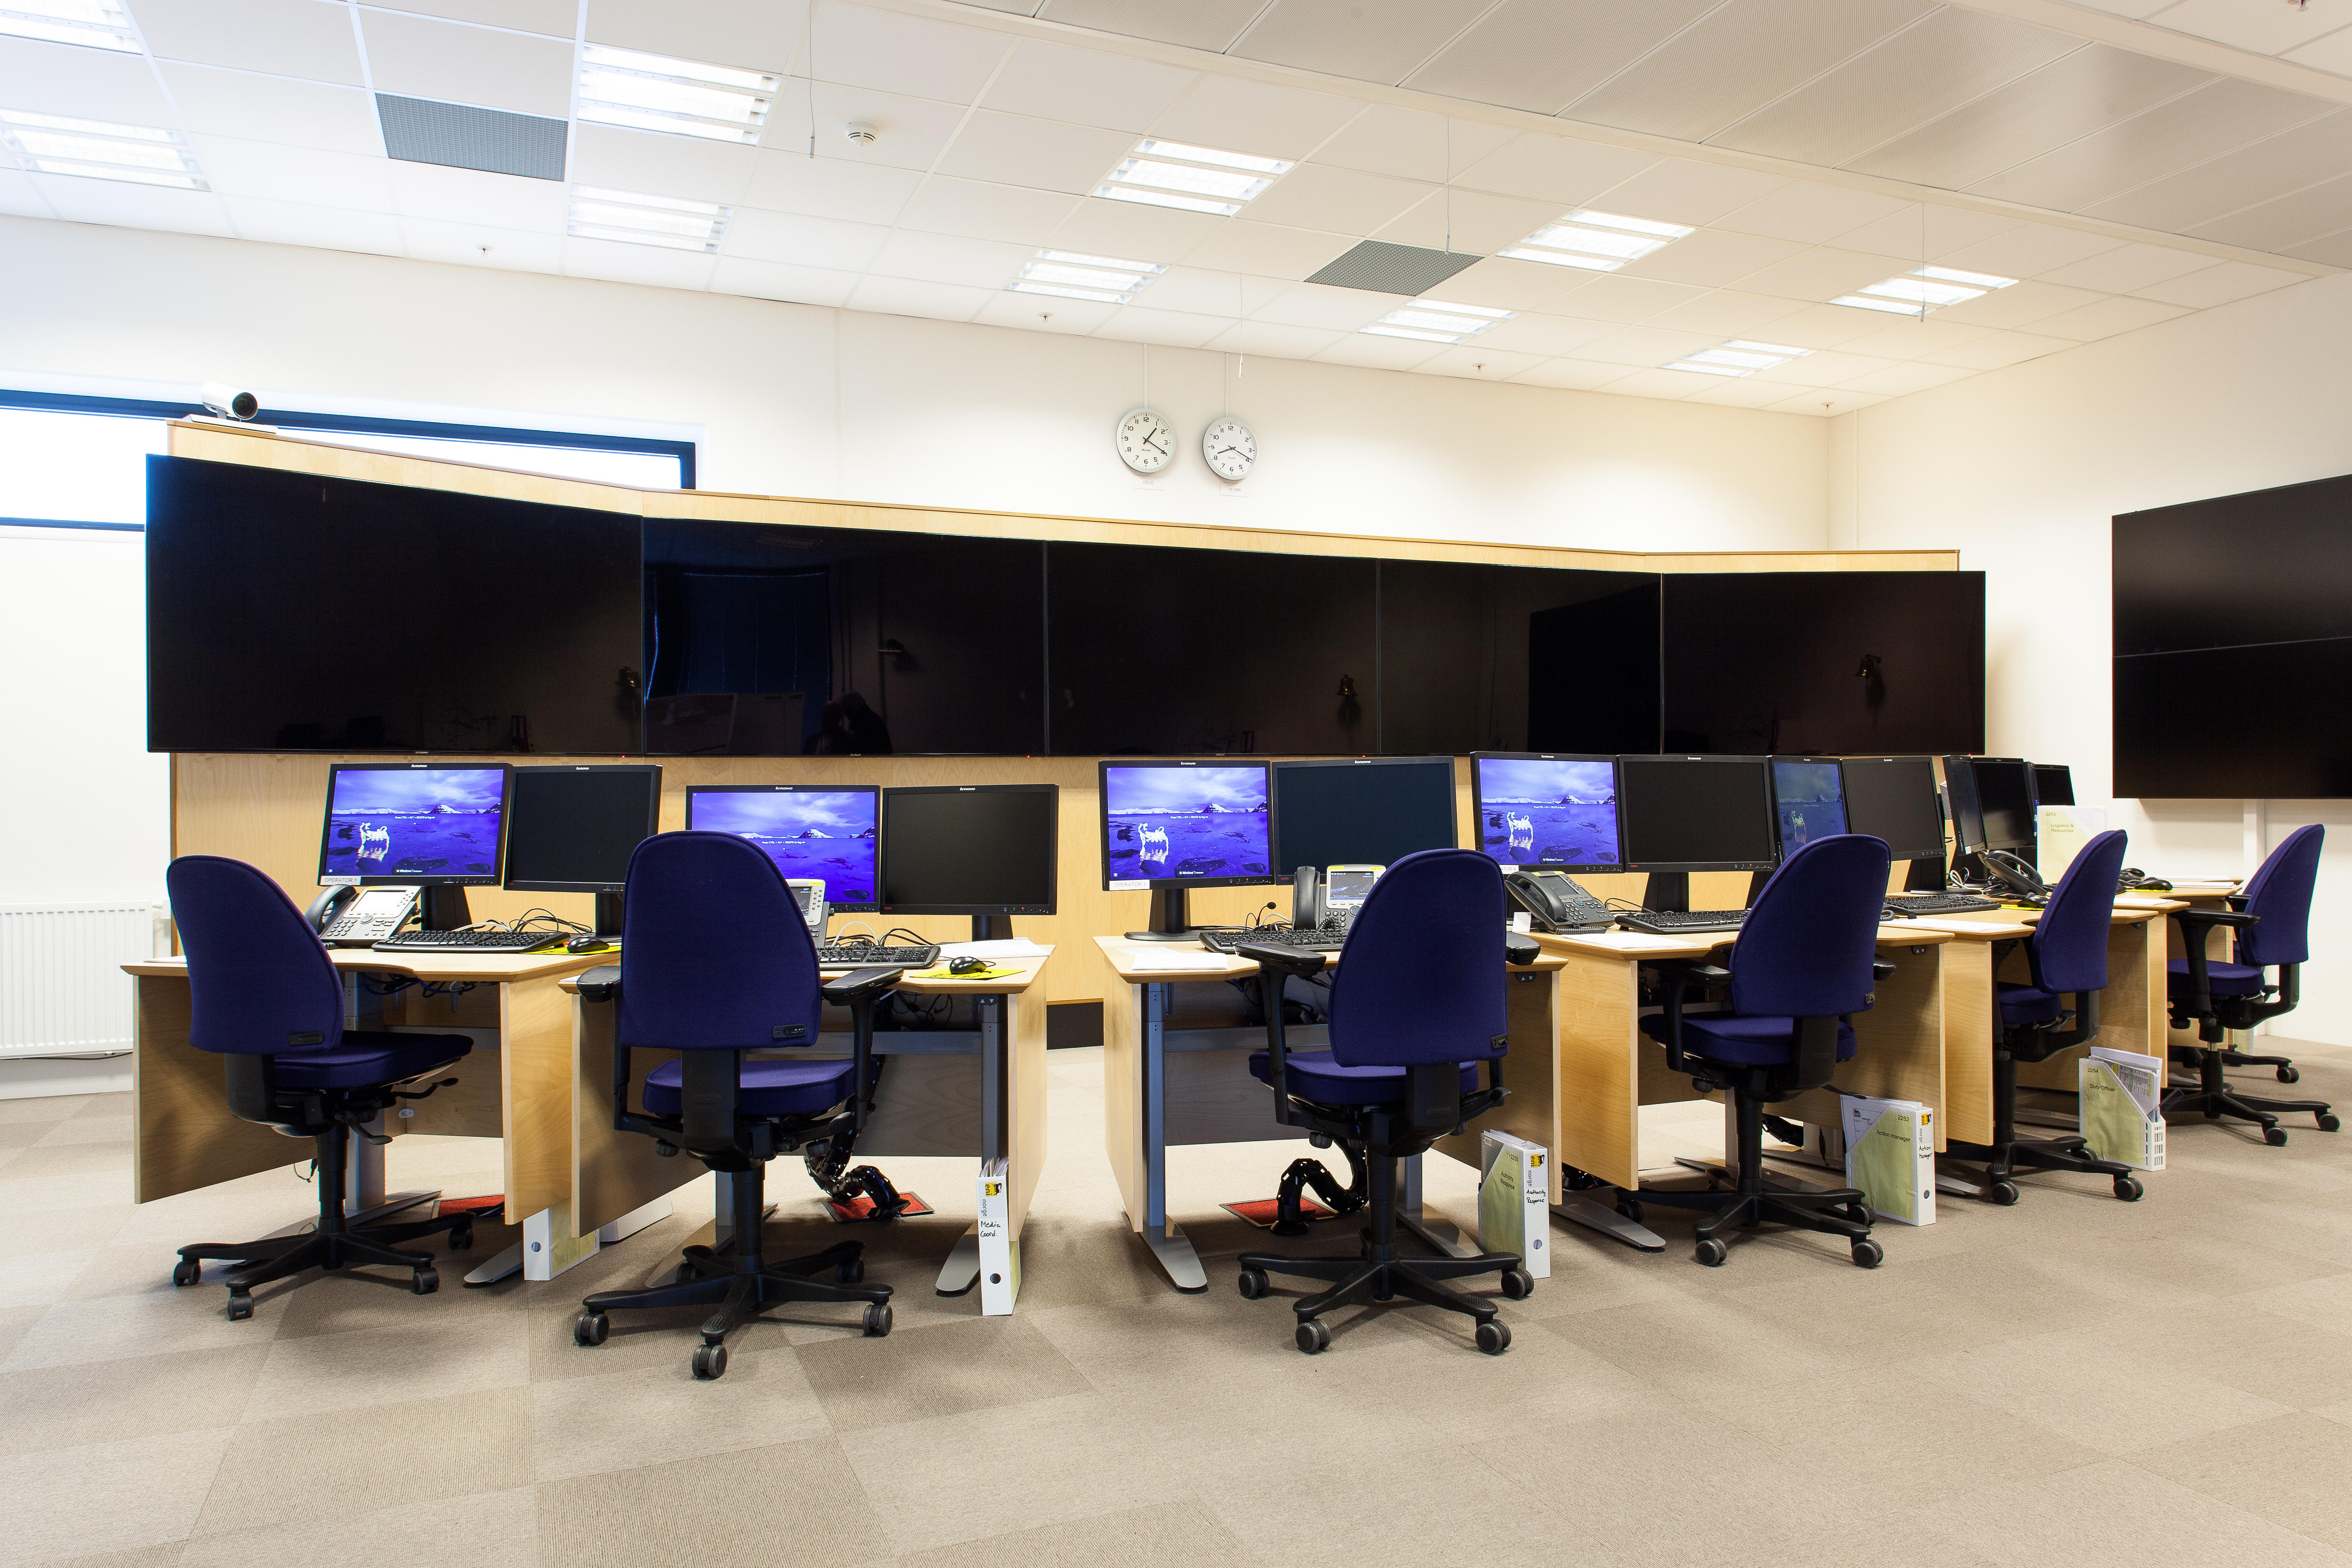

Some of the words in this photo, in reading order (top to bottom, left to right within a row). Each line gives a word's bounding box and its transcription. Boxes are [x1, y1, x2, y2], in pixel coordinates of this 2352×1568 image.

[1890, 1134, 1911, 1142] manager
[1501, 1171, 1514, 1183] Authority
[1500, 1178, 1515, 1190] Response
